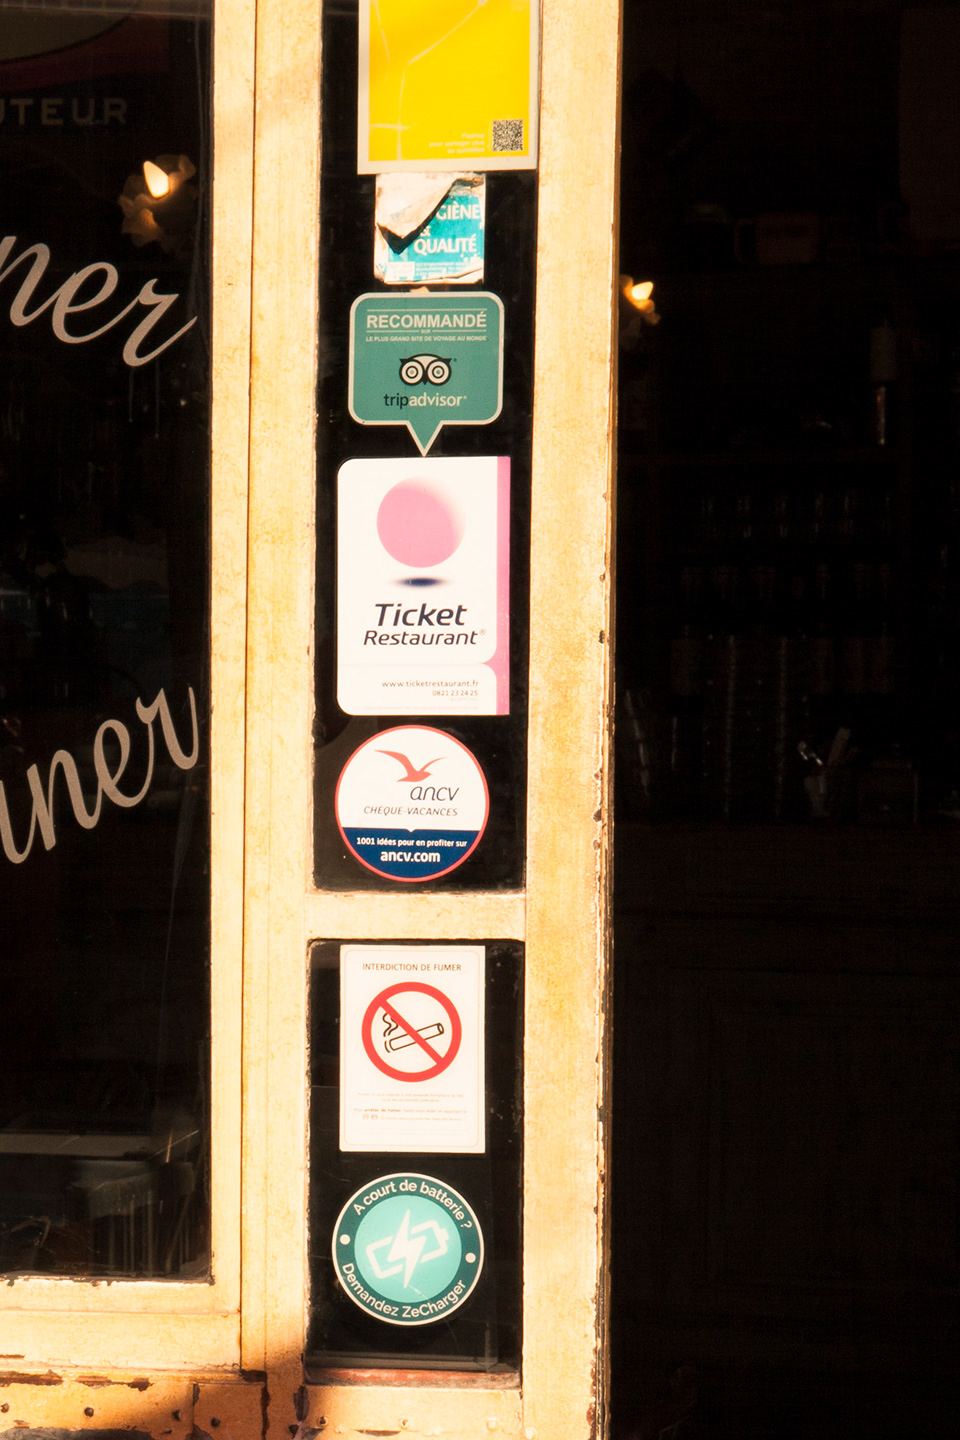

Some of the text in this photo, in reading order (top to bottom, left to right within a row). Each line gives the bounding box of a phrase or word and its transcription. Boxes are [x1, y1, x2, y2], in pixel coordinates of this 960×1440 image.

[436, 201, 480, 220] GIÈNE
[414, 233, 477, 256] QUALITÉ
[366, 311, 487, 328] RECOMMANDÉ
[383, 392, 463, 409] tripadvisor
[374, 603, 467, 627] Ticket
[363, 630, 478, 646] Restaurant
[381, 679, 479, 687] www.ticketrestaurant.fr
[410, 786, 460, 801] ancv
[356, 837, 375, 845] 1001
[376, 837, 396, 846] idées
[397, 838, 415, 847] pour
[426, 838, 454, 847] profiter
[380, 851, 440, 862] ancv.com
[362, 963, 418, 971] INTERDICTION
[420, 963, 431, 971] DE
[353, 1203, 365, 1215] A
[363, 1181, 397, 1206] court
[399, 1179, 417, 1191] de
[420, 1181, 465, 1220] batterie
[342, 1263, 466, 1318] Demandez ZeCharger
